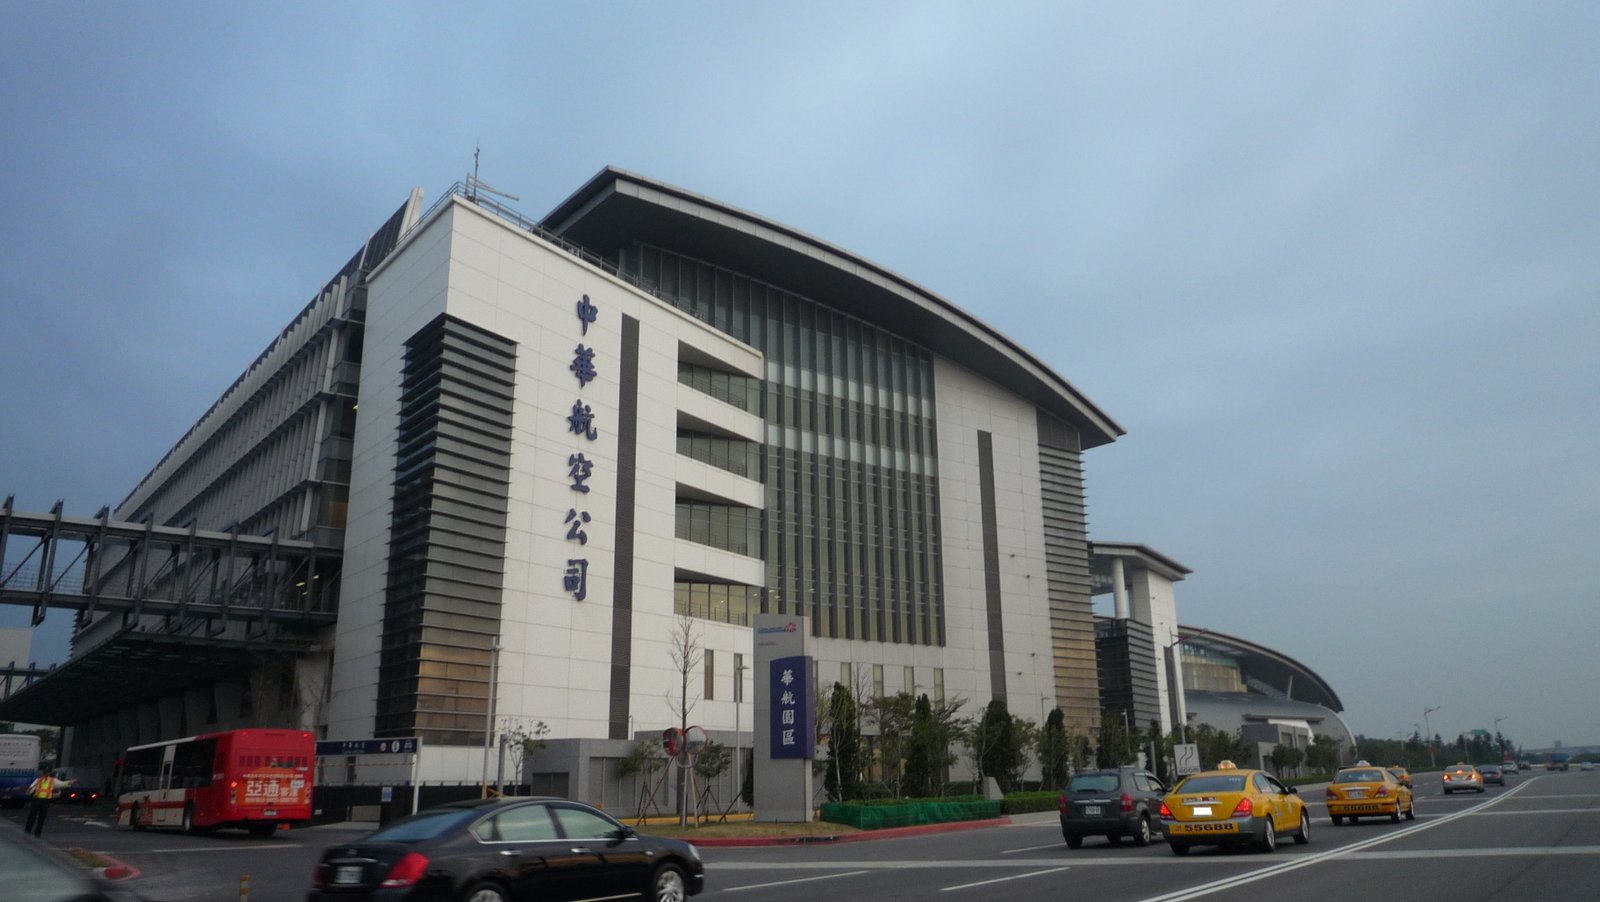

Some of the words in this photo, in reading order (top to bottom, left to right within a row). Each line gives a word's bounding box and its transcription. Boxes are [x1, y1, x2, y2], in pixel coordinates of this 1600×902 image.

[563, 294, 598, 602] 中華航空公司
[781, 669, 795, 745] 華航園區
[1184, 823, 1234, 832] 55688
